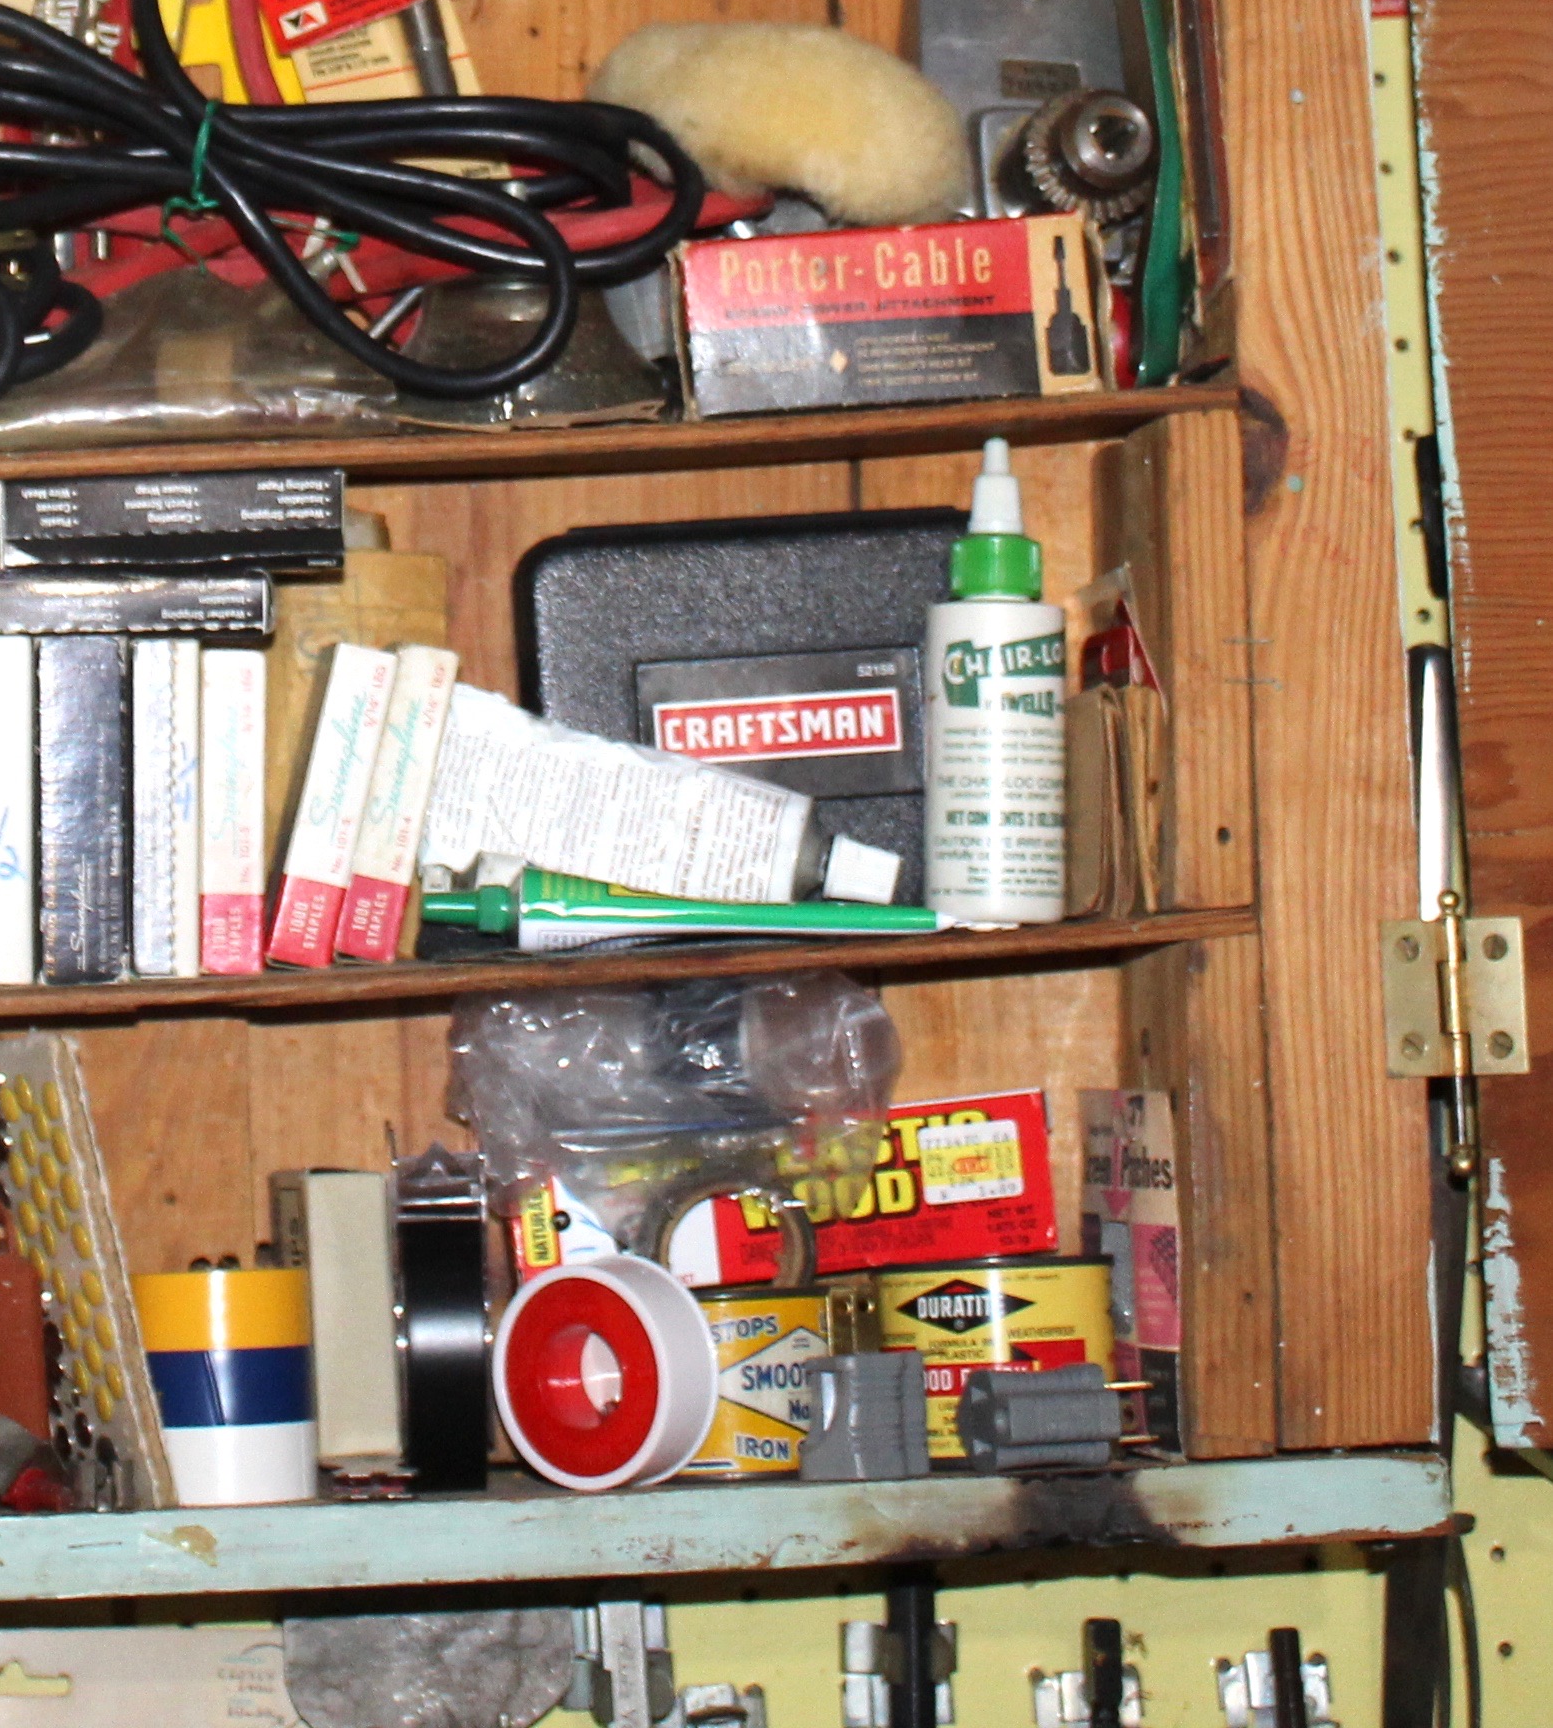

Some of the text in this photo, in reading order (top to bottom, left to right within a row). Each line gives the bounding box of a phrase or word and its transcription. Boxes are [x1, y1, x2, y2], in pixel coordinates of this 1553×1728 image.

[718, 236, 992, 297] Porter-Cable
[663, 705, 886, 751] CRAFTSMAN
[289, 900, 308, 934] 1000
[303, 893, 326, 950] STAPLES
[351, 897, 370, 931] 1000
[365, 890, 389, 948] STAPLES
[709, 1315, 778, 1345] STOPS
[735, 1434, 791, 1461] IRON
